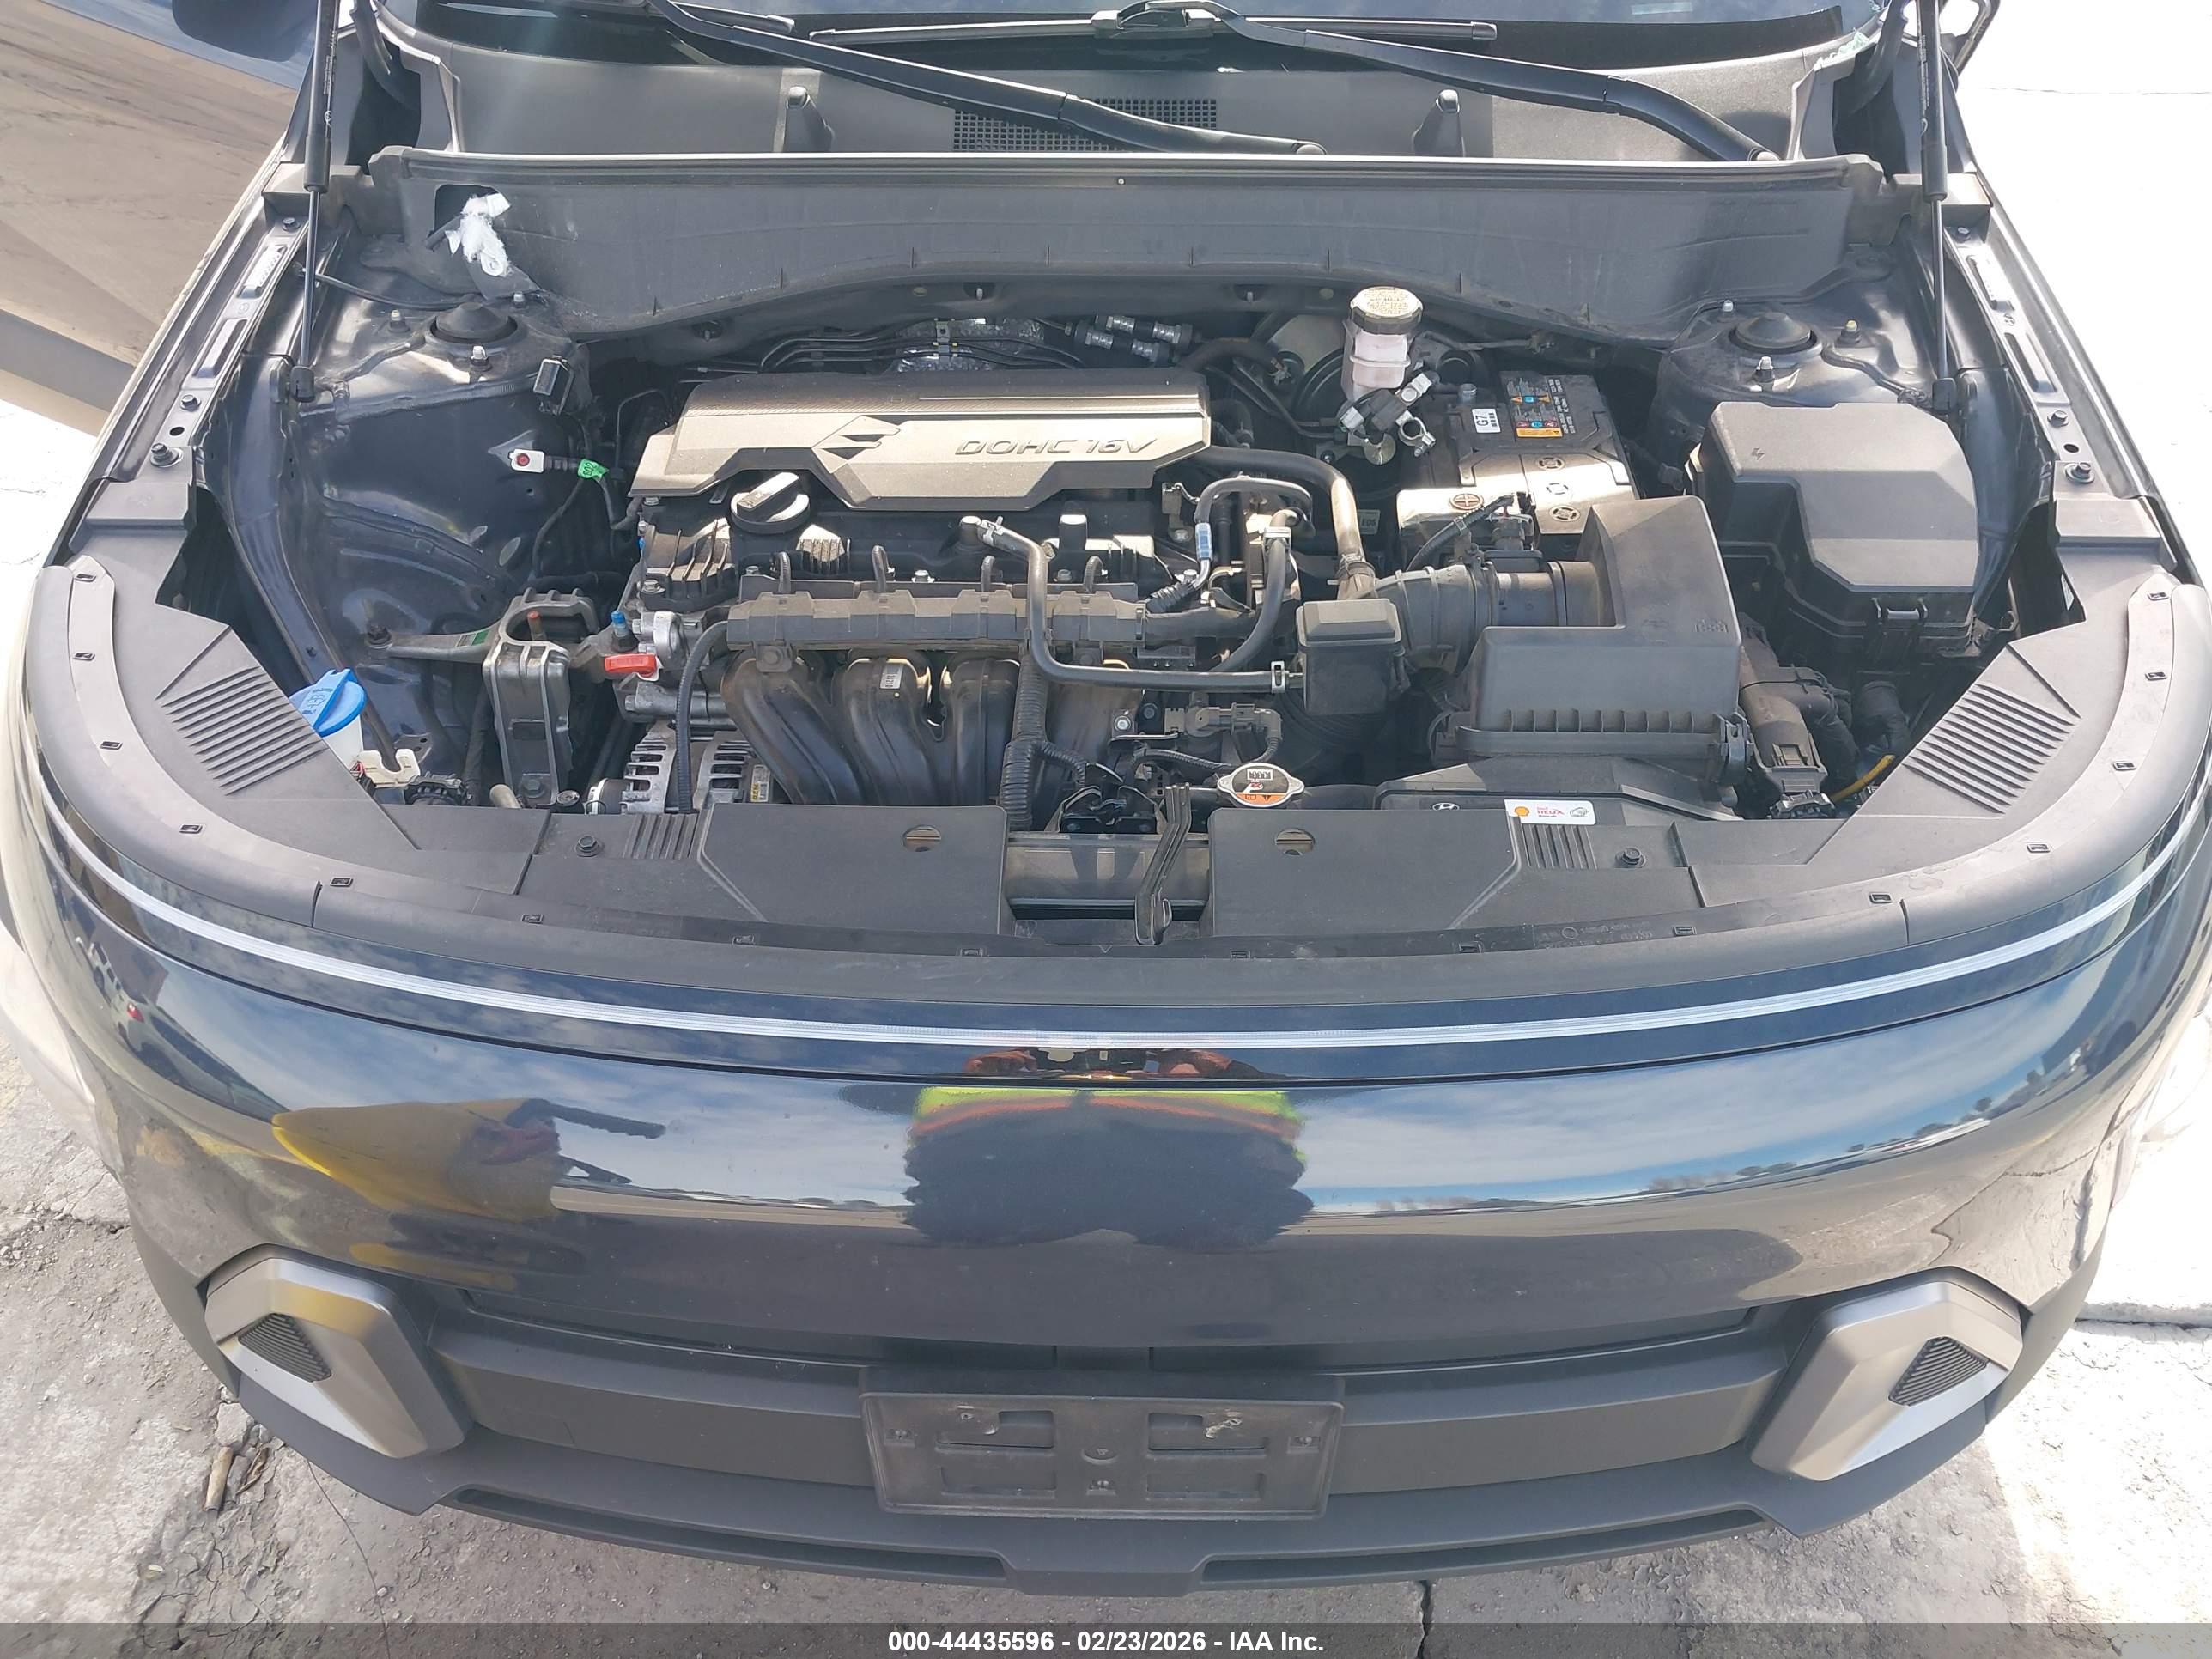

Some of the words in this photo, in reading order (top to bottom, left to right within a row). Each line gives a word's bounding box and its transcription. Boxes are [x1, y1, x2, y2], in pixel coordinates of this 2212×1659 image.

[1474, 415, 1489, 427] G7
[955, 439, 1078, 455] DOHC
[1085, 438, 1158, 454] 16V
